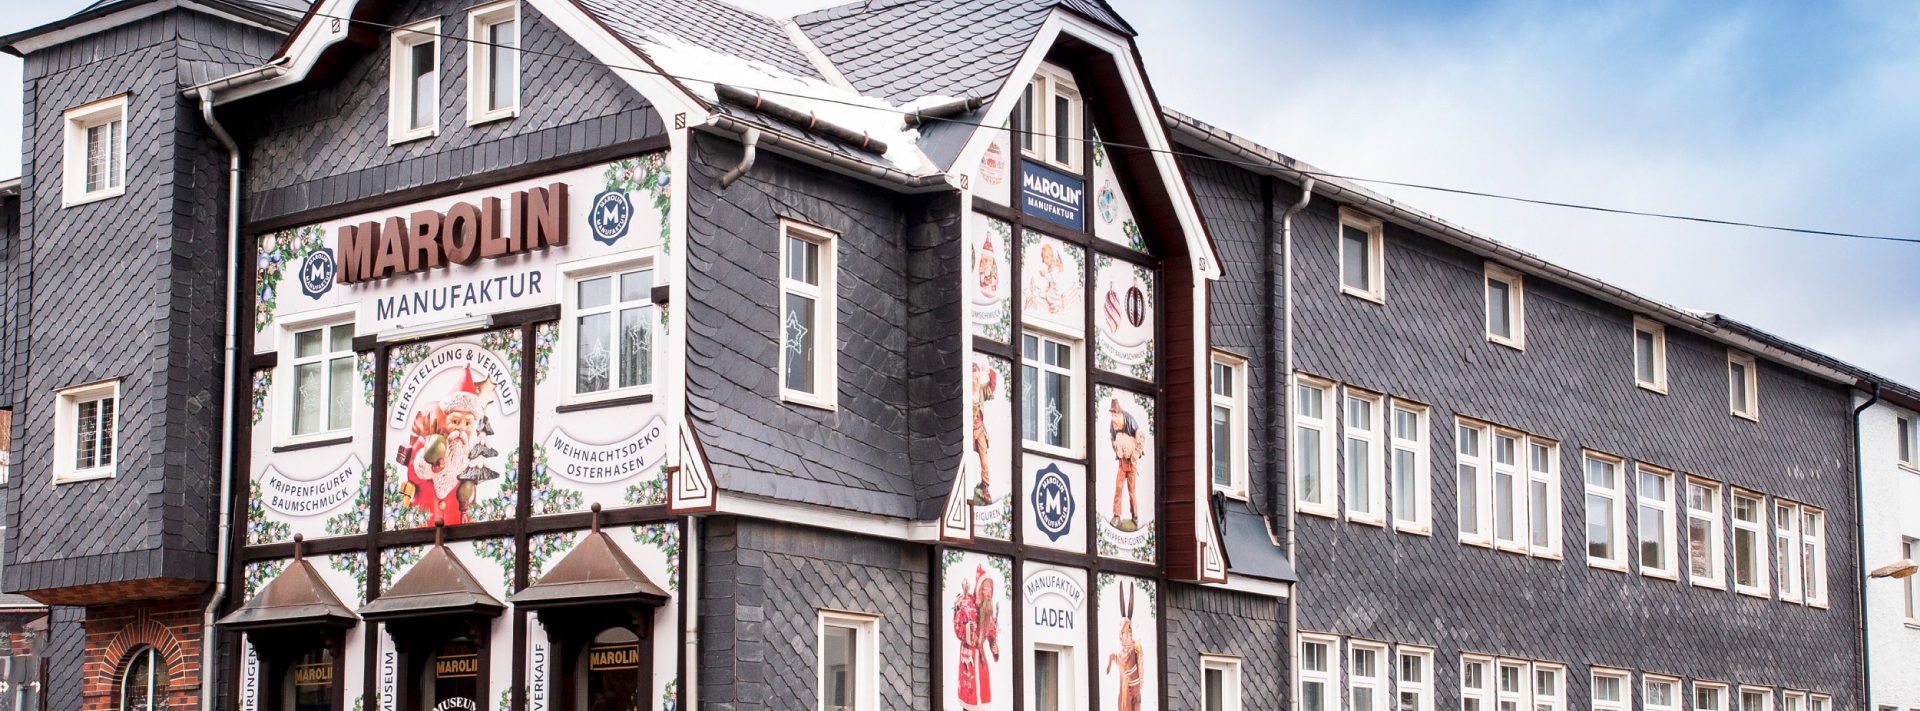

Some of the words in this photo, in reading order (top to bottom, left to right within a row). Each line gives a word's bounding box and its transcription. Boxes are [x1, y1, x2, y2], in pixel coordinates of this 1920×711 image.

[600, 195, 623, 208] MAROLIN
[1028, 197, 1075, 220] MANUFAKTUR
[597, 214, 626, 235] MANUFAKTUR
[603, 203, 619, 226] M
[337, 182, 569, 285] MAROLIN
[311, 262, 325, 281] M
[377, 270, 542, 321] MANUFAKTUR
[396, 348, 462, 422] HERSTELLUNG
[466, 349, 474, 361] &
[477, 353, 514, 407] VERKAUF
[554, 426, 660, 463] WEIHNACHTSDEKO
[567, 456, 645, 479] OSTERHASEN
[269, 466, 353, 497] KRIPPENFIGUREN
[1042, 477, 1065, 493] MAROLIN
[271, 487, 349, 512] BAUMSCHMUCK
[1045, 487, 1062, 515] M
[1038, 502, 1068, 528] MANUFAKTUR
[1027, 575, 1080, 603] MANUFAKTUR
[1034, 606, 1074, 630] LADEN
[534, 643, 544, 711] VERKAUF
